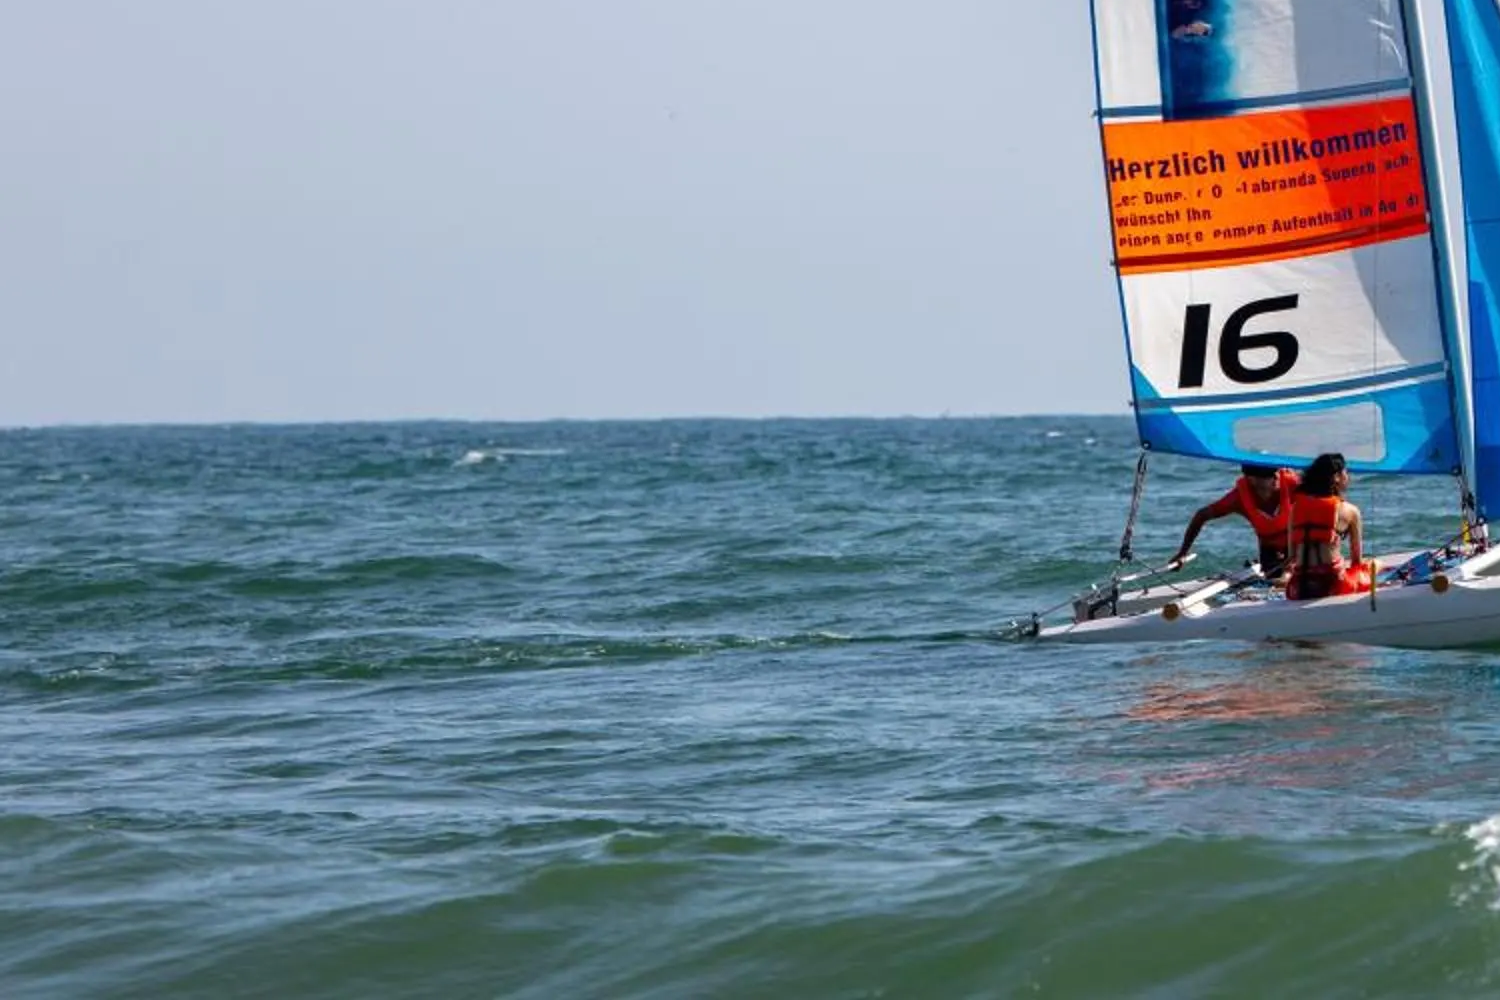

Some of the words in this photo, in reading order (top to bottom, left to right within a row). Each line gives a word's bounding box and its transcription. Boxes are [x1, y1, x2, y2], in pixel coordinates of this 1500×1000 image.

[1108, 149, 1225, 182] Herzlich
[1237, 122, 1408, 170] willkommen
[1178, 293, 1299, 389] 16
